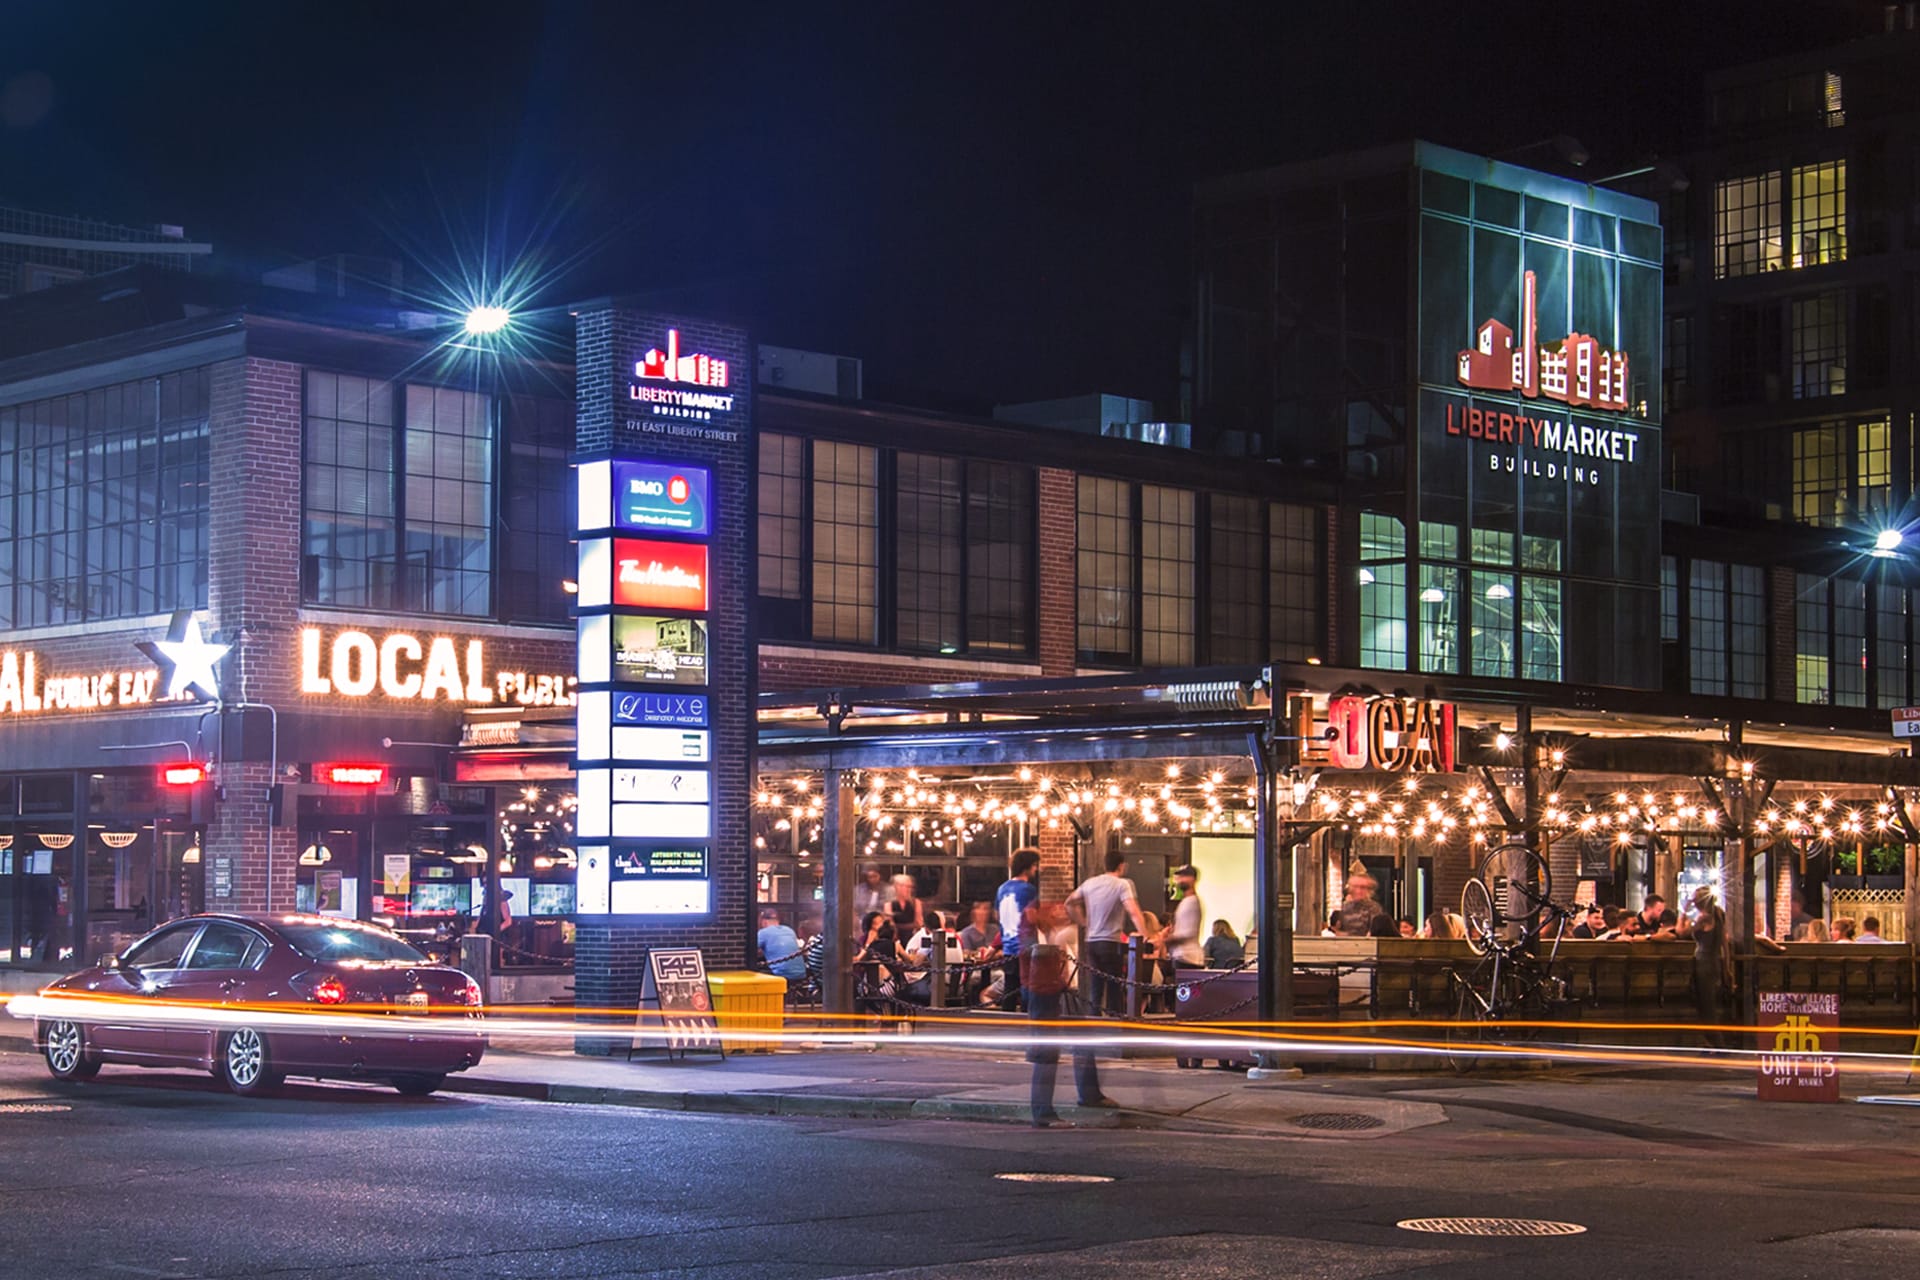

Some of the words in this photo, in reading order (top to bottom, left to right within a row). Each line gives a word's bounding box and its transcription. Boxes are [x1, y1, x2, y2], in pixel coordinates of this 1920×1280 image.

[626, 420, 640, 431] 171
[642, 421, 664, 435] EAST
[667, 424, 703, 438] LIBERTY
[704, 429, 738, 442] STREET
[1490, 455, 1599, 485] BUILDING
[302, 628, 494, 702] LOCAL
[43, 671, 114, 709] PUBLIC
[1760, 1002, 1789, 1013] HOME
[1790, 1004, 1838, 1014] HARDWARE
[1762, 1055, 1803, 1076] UNIT
